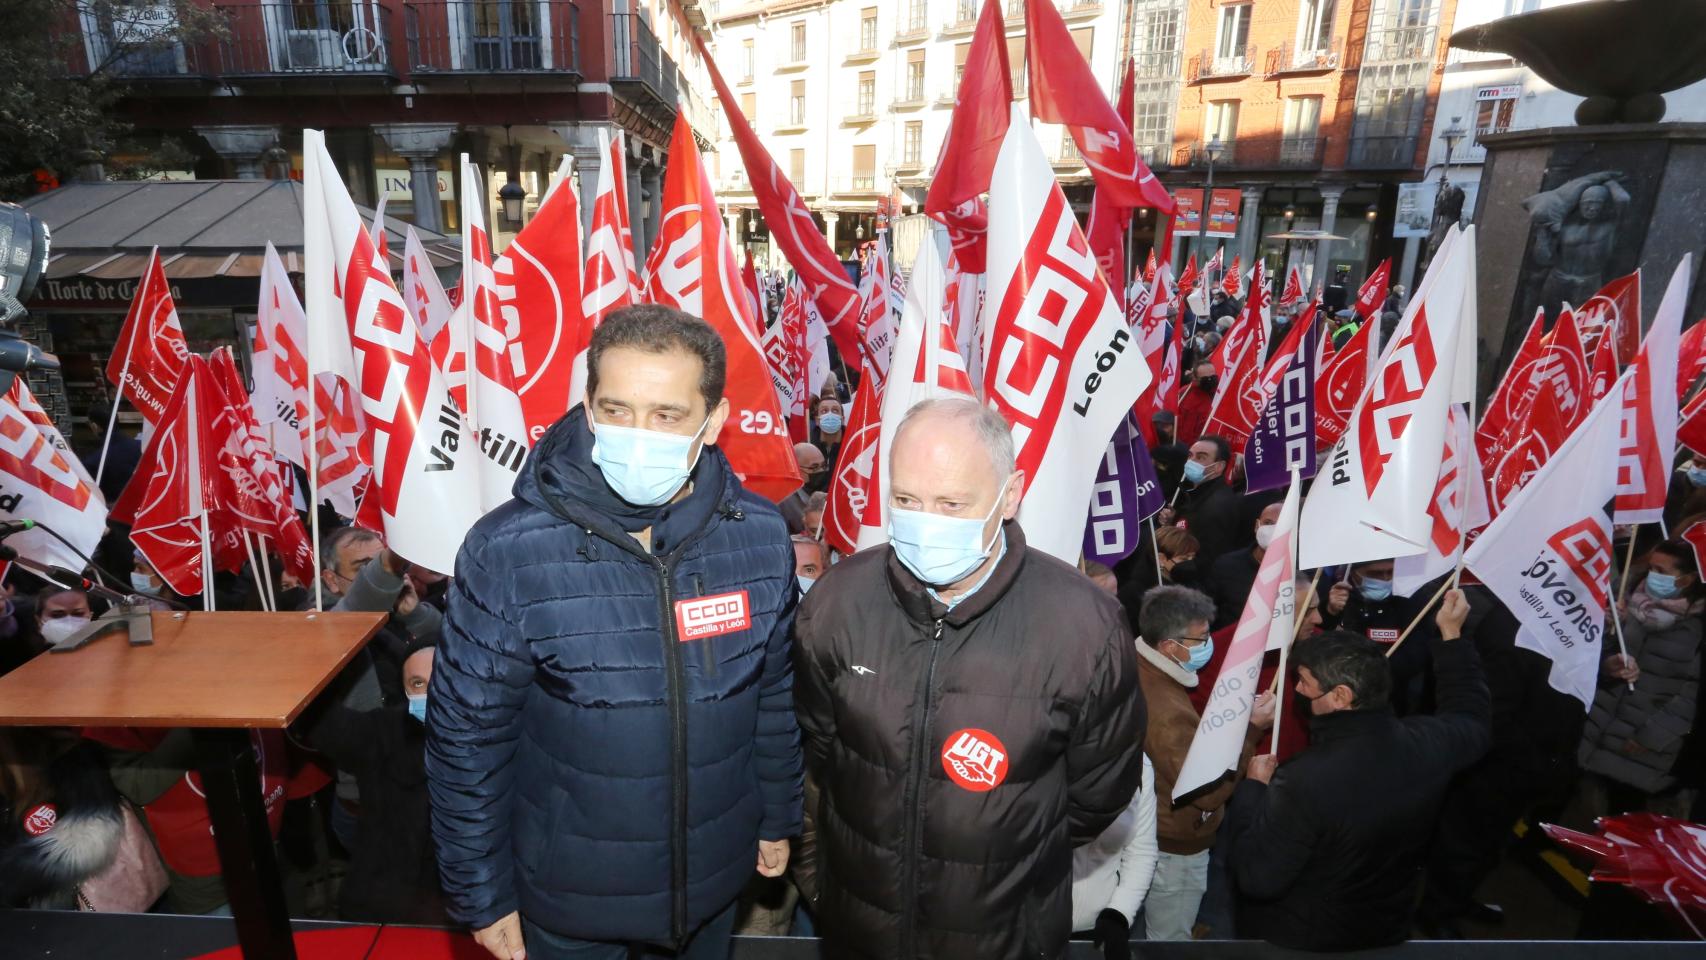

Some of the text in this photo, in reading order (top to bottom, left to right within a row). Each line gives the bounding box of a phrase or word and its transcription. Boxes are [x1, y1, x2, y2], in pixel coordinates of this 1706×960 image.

[46, 280, 93, 300] Norte
[95, 281, 114, 300] de
[1073, 328, 1131, 418] León
[1254, 429, 1264, 464] León
[687, 600, 740, 621] CCOO
[684, 618, 746, 637] Castilla y León
[1548, 619, 1576, 650] León
[951, 732, 1005, 776] UGT
